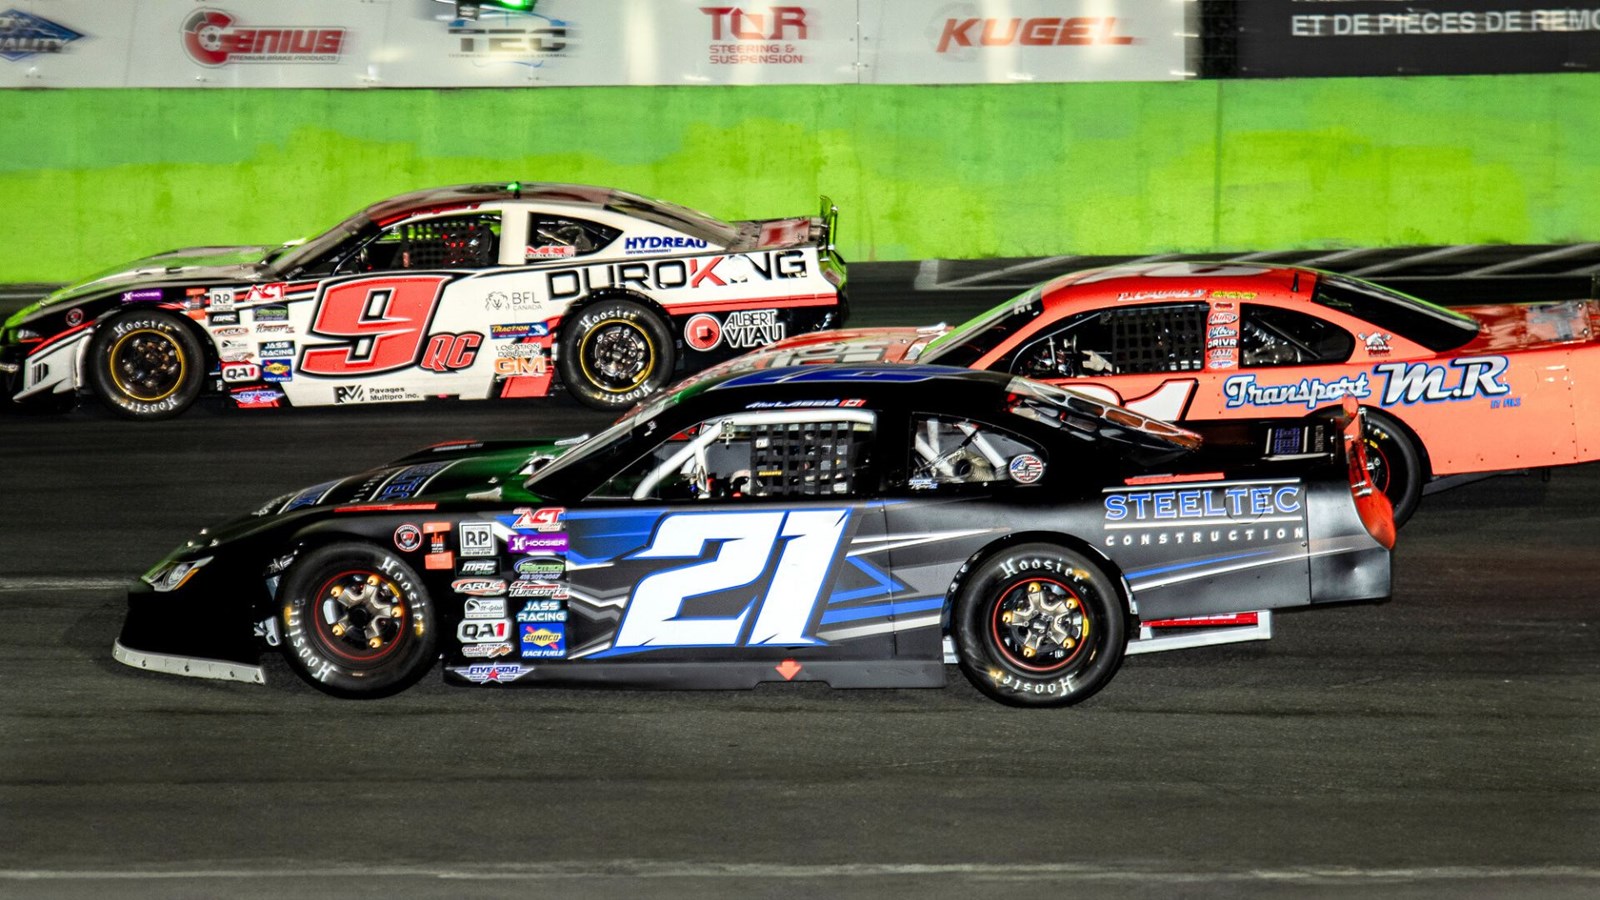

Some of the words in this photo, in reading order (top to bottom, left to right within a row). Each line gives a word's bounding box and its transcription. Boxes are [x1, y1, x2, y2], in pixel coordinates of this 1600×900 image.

[1292, 15, 1326, 36] ET
[1334, 15, 1370, 35] DE
[1379, 8, 1477, 34] PIÈCES
[1486, 11, 1522, 32] DE
[184, 11, 344, 64] GENIUS
[449, 29, 566, 51] TEC
[936, 17, 1134, 53] KUGEL
[709, 44, 779, 53] STEERING
[785, 44, 795, 53] &
[709, 55, 803, 64] SUSPENSION
[625, 237, 707, 249] HYDREAU
[546, 250, 808, 301] DUROKNG
[214, 294, 231, 304] RP
[245, 283, 288, 301] ACT
[512, 292, 540, 304] BFL
[296, 274, 452, 378] 9
[418, 331, 484, 373] QC
[723, 310, 777, 328] ALBERT
[723, 324, 785, 348] VIAU
[496, 343, 540, 351] LOCATION
[226, 367, 255, 379] QA1
[494, 356, 546, 375] GM
[1224, 373, 1371, 409] Transport
[1375, 355, 1510, 406] M.R
[1104, 486, 1300, 521] STEELTEC
[513, 507, 565, 526] ACT
[465, 530, 489, 546] RP
[525, 539, 566, 547] HOOSIER
[1105, 527, 1304, 547] CONSTRUCTION
[462, 560, 497, 571] MAC
[1000, 557, 1086, 583] Hoosier
[613, 507, 851, 648] 21
[377, 556, 426, 635] Hoosier
[524, 600, 560, 611] JASS
[517, 611, 567, 622] RACING
[462, 623, 505, 640] QA1
[284, 606, 340, 682] Hoosier
[469, 666, 493, 674] FIVE
[988, 670, 1078, 697] Hoosier
